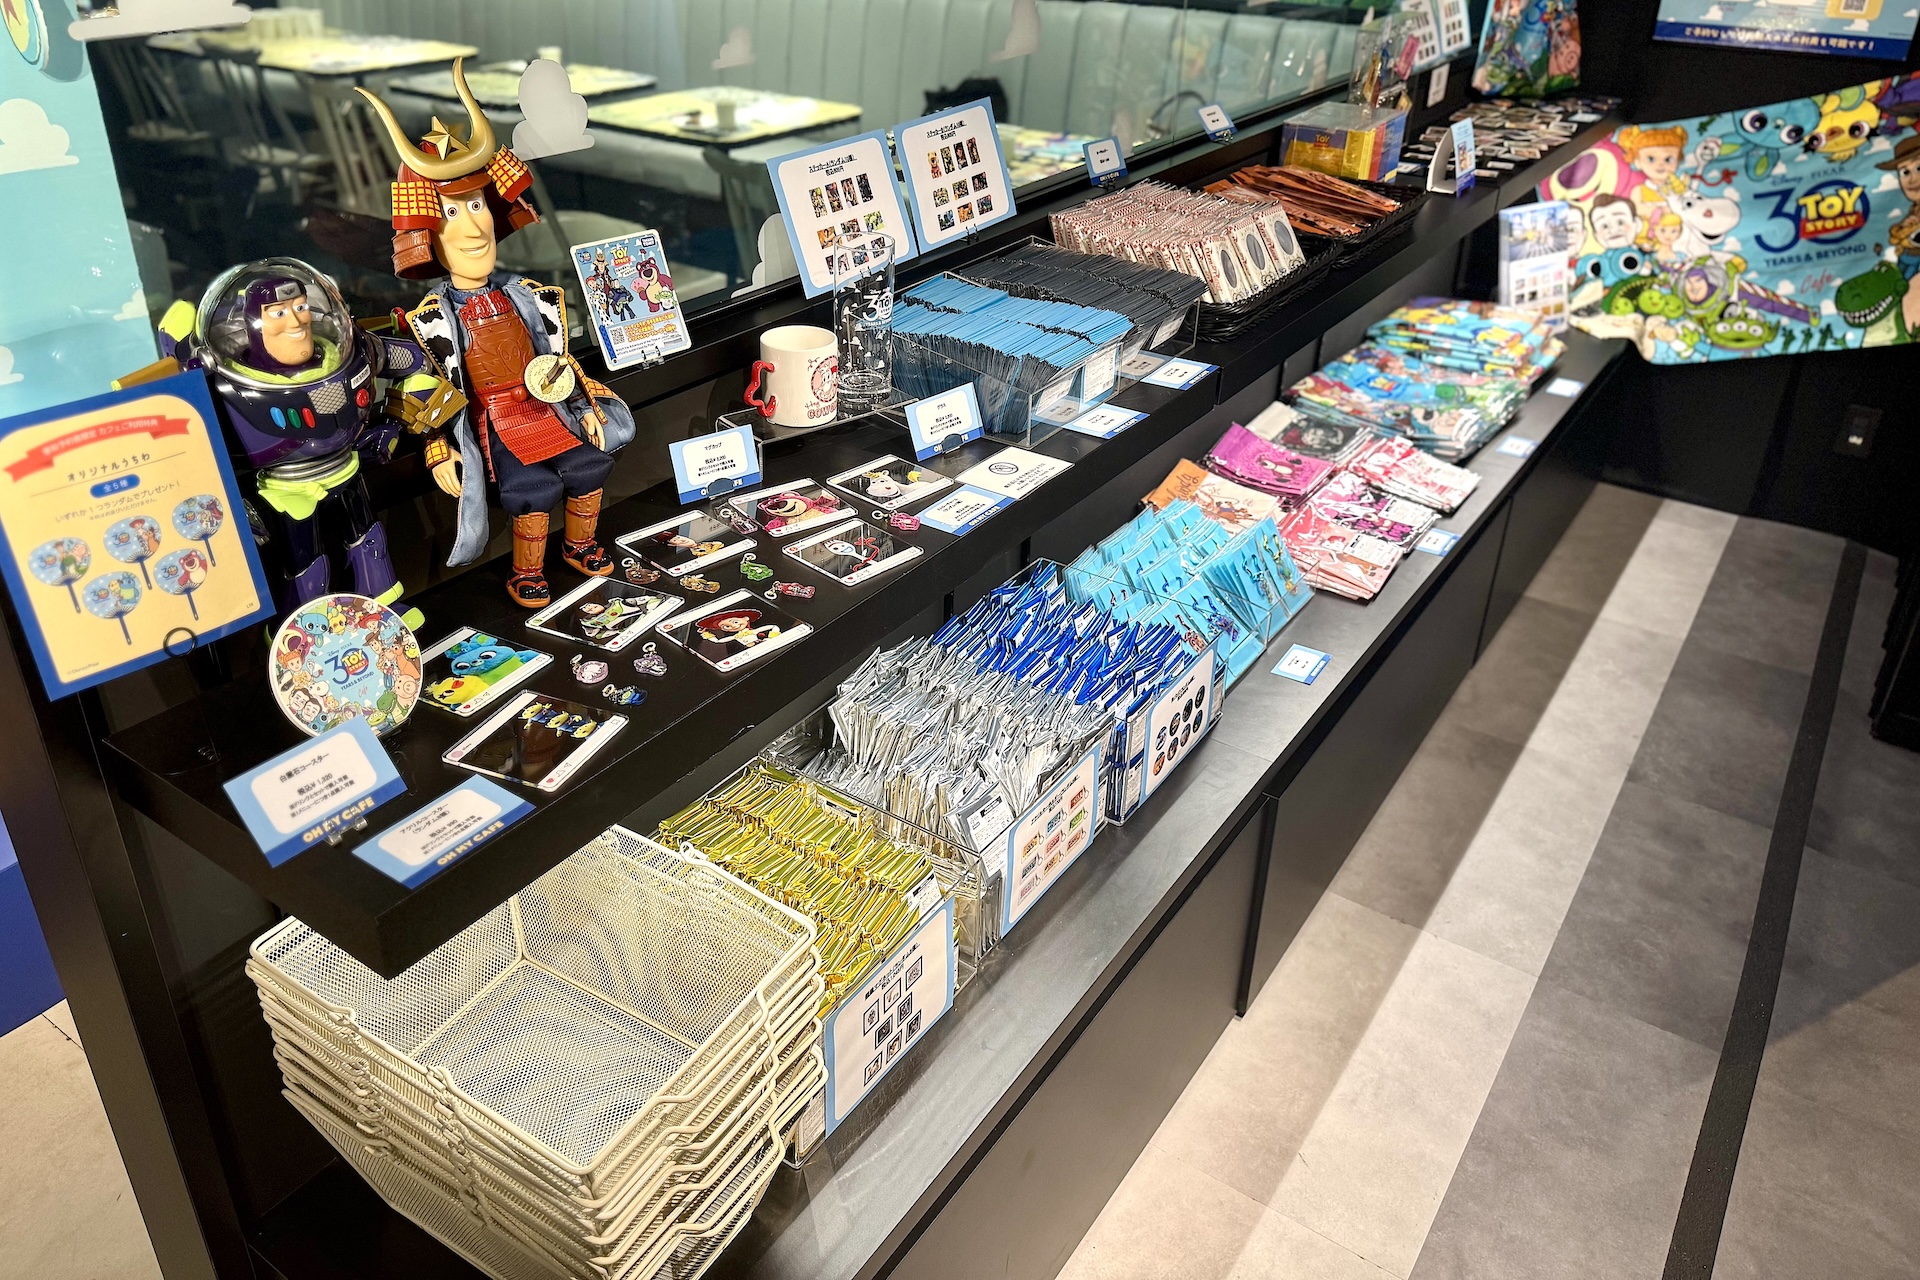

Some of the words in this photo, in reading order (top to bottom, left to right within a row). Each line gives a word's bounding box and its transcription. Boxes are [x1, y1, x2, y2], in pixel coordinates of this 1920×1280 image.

[1798, 185, 1865, 220] TOY
[1805, 214, 1858, 234] STORY
[610, 246, 628, 259] TOY
[1816, 243, 1867, 259] BEYOND
[68, 452, 151, 482] オリジナルうちわ
[341, 648, 363, 667] TOY
[349, 660, 366, 671] STORY
[341, 681, 354, 691] YEARS
[358, 671, 374, 682] BEYOND
[303, 826, 324, 843] OH
[437, 852, 457, 865] OH
[455, 840, 473, 853] MY
[473, 820, 505, 842] CAFE
